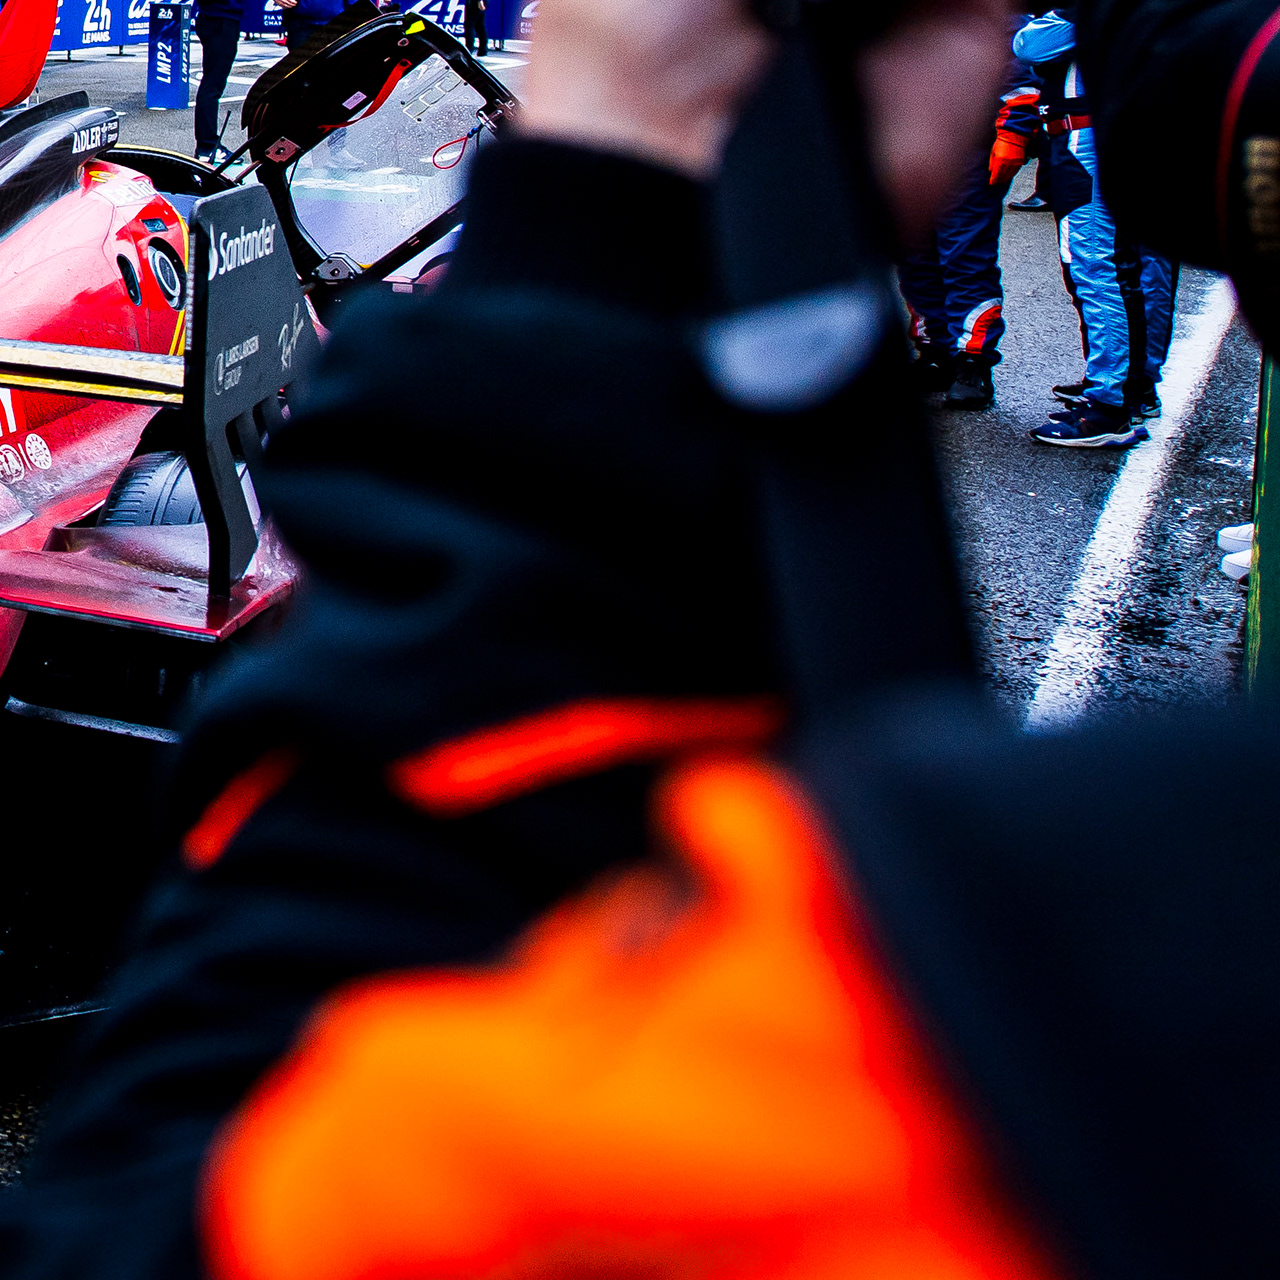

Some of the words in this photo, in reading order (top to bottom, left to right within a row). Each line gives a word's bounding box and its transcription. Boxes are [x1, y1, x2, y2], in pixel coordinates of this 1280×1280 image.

[156, 41, 172, 84] LMP2
[72, 126, 101, 155] ADLER
[218, 218, 276, 275] Santander
